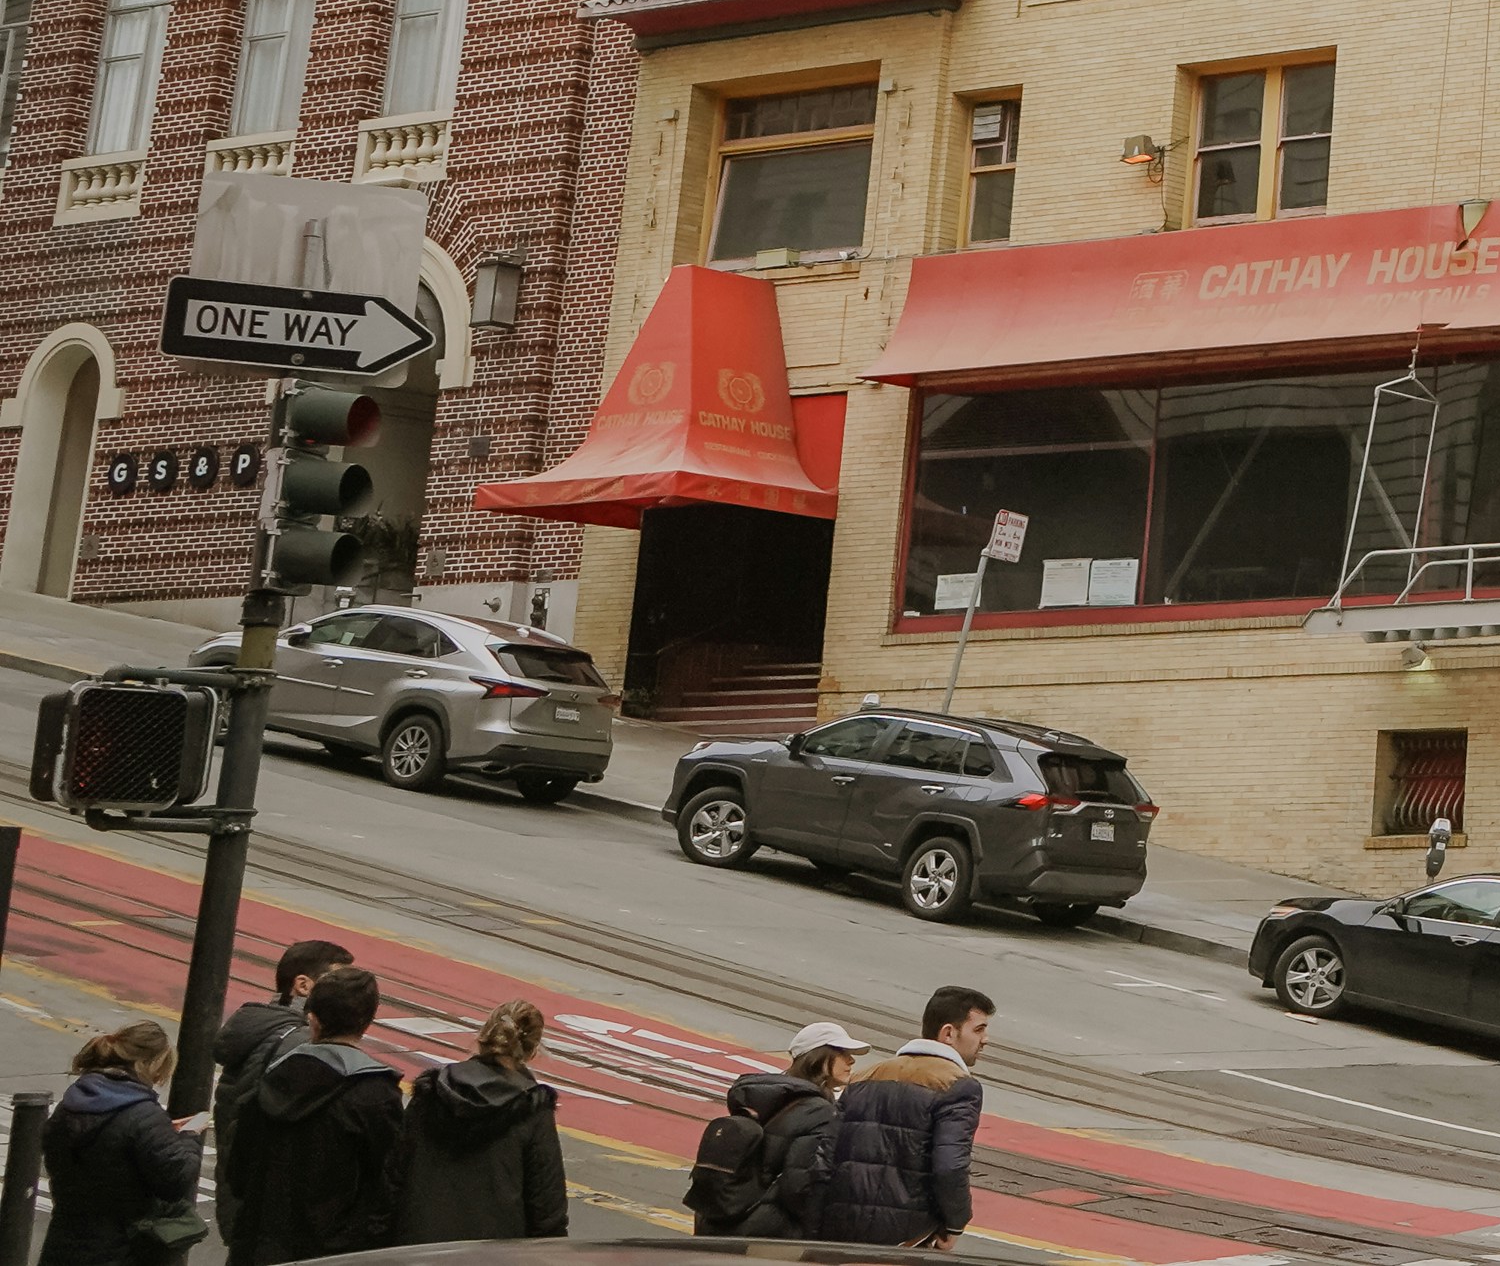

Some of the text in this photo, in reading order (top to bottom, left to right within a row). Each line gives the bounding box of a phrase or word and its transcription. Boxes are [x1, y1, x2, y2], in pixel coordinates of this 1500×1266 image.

[1199, 252, 1351, 300] CATHAY
[196, 304, 358, 347] ONE WAY
[699, 411, 793, 441] CATHAY HOUSE
